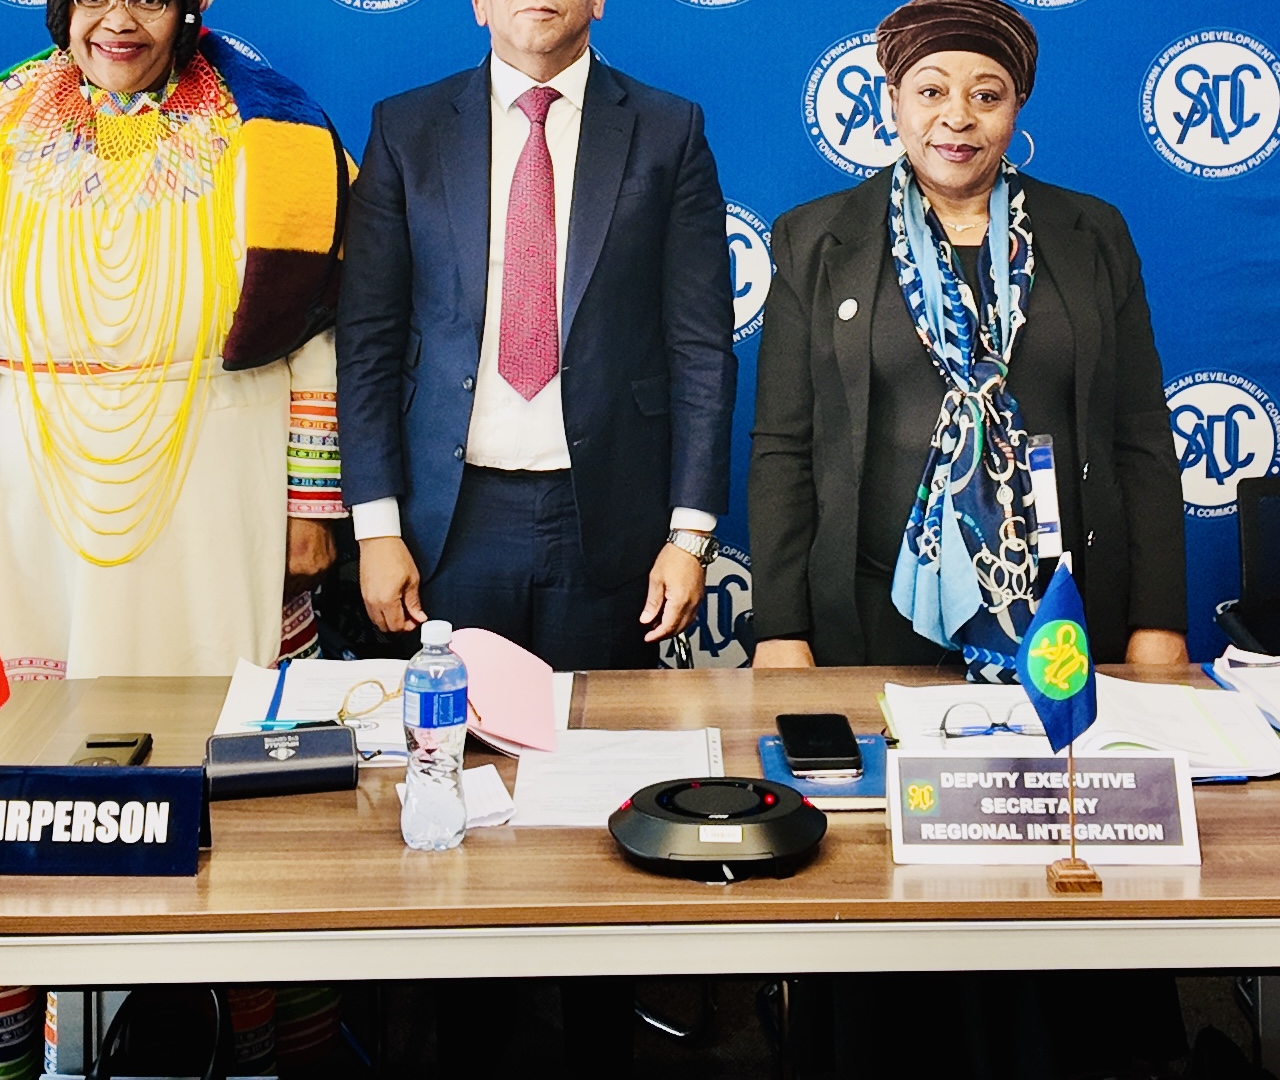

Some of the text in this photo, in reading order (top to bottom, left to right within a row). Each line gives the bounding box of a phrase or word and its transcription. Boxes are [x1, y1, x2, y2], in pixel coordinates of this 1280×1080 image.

[1142, 65, 1162, 123] SOUTHERN
[1158, 34, 1200, 67] AFRICAN
[1200, 31, 1276, 62] DEVELOPMENT
[1153, 136, 1194, 173] TOWARDS
[1202, 162, 1248, 179] COMMON
[1247, 137, 1280, 169] FUTURE
[940, 772, 1136, 789] DEPUTY EXECUTIVE
[980, 797, 1099, 815] SECRETARY
[920, 823, 1164, 841] REGIONAL INTEGRATION
